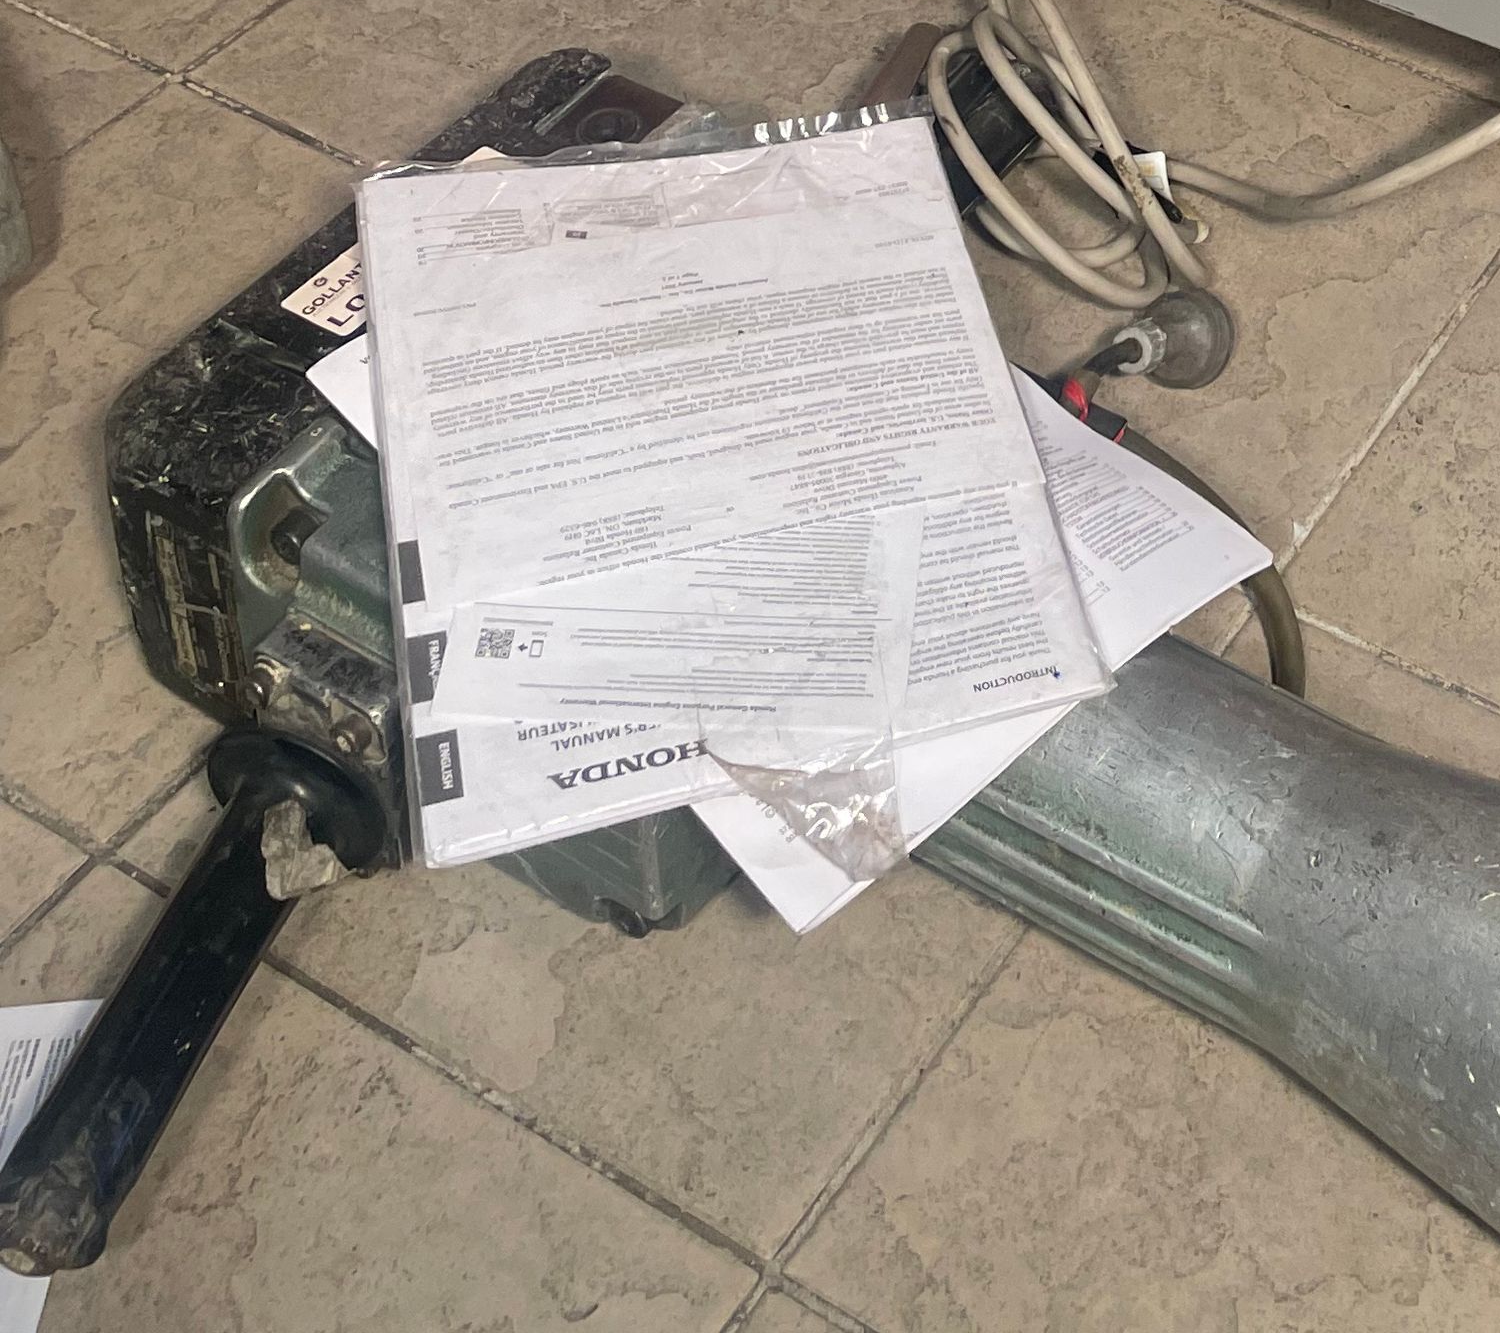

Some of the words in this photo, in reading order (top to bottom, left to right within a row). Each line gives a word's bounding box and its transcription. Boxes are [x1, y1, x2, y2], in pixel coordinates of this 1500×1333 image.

[971, 665, 1057, 692] INTRODUCTION
[548, 724, 621, 753] MANUAL
[435, 741, 455, 790] ENGLISH
[544, 738, 710, 792] HONDA
